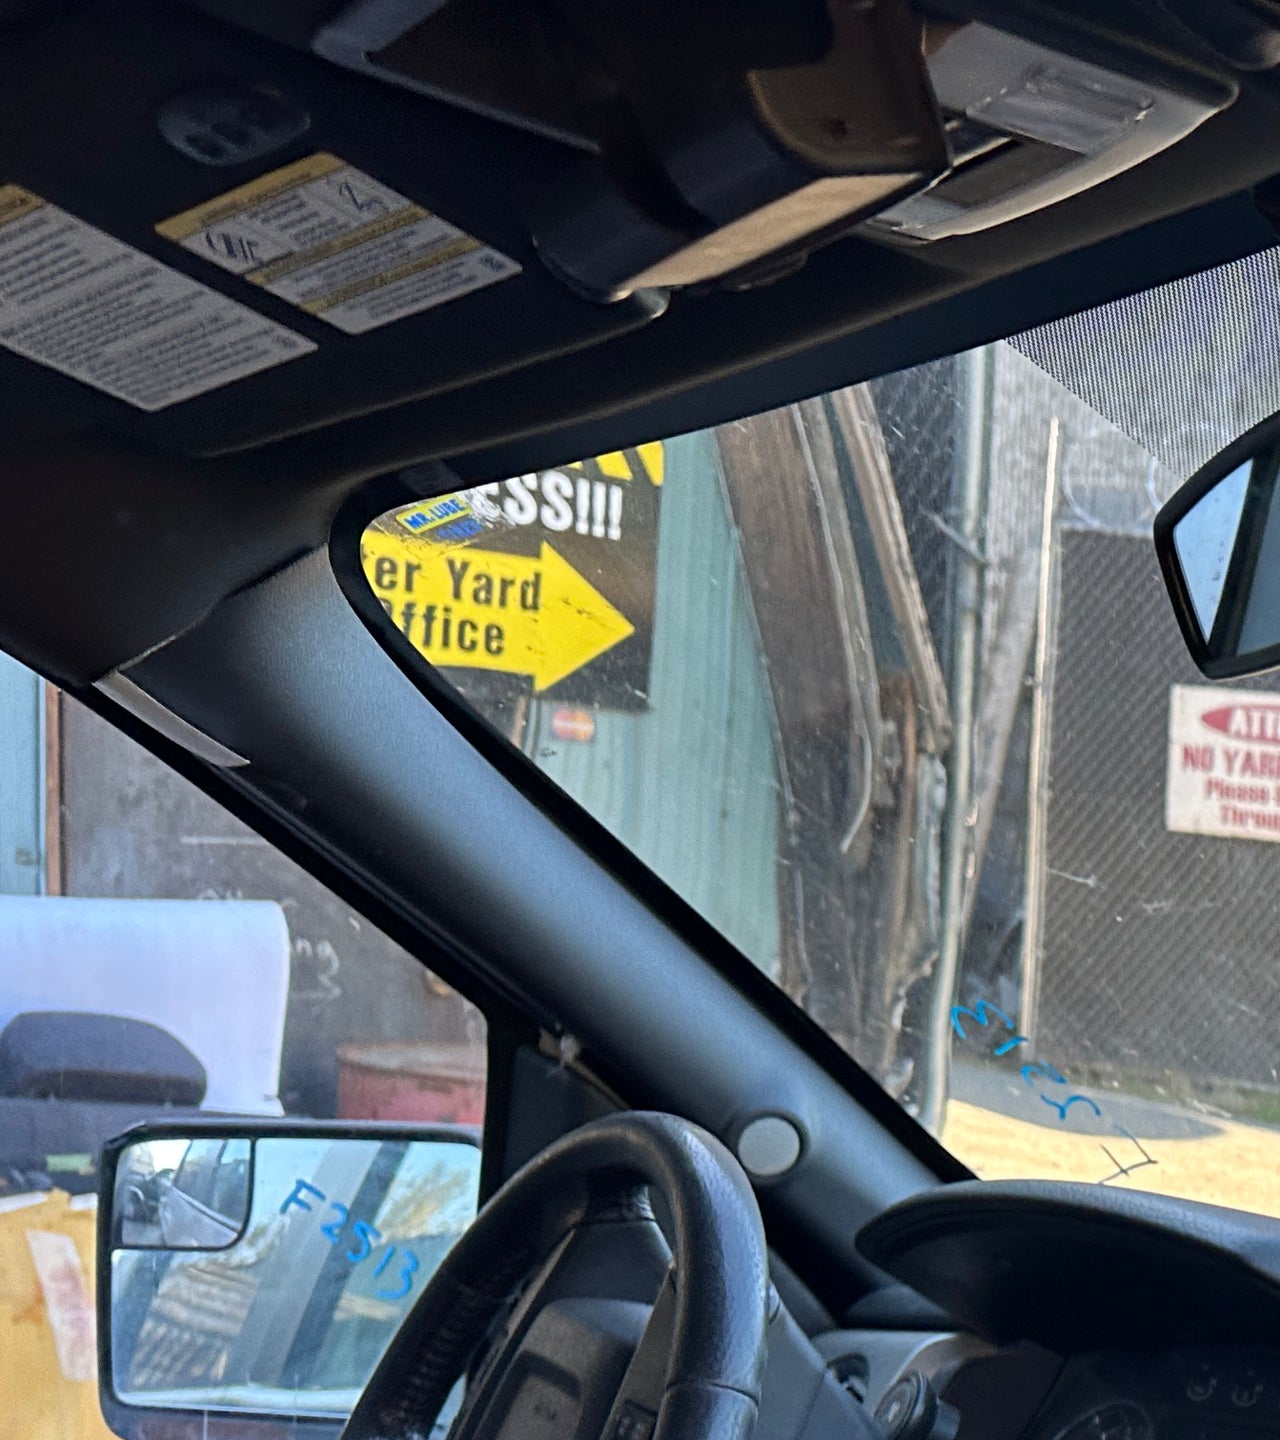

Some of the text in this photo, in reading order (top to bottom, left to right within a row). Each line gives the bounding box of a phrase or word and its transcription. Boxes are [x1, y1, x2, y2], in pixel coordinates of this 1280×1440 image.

[428, 499, 465, 519] LUBE
[446, 557, 542, 612] Yard
[1181, 745, 1214, 772] NO
[1206, 777, 1269, 804] Please
